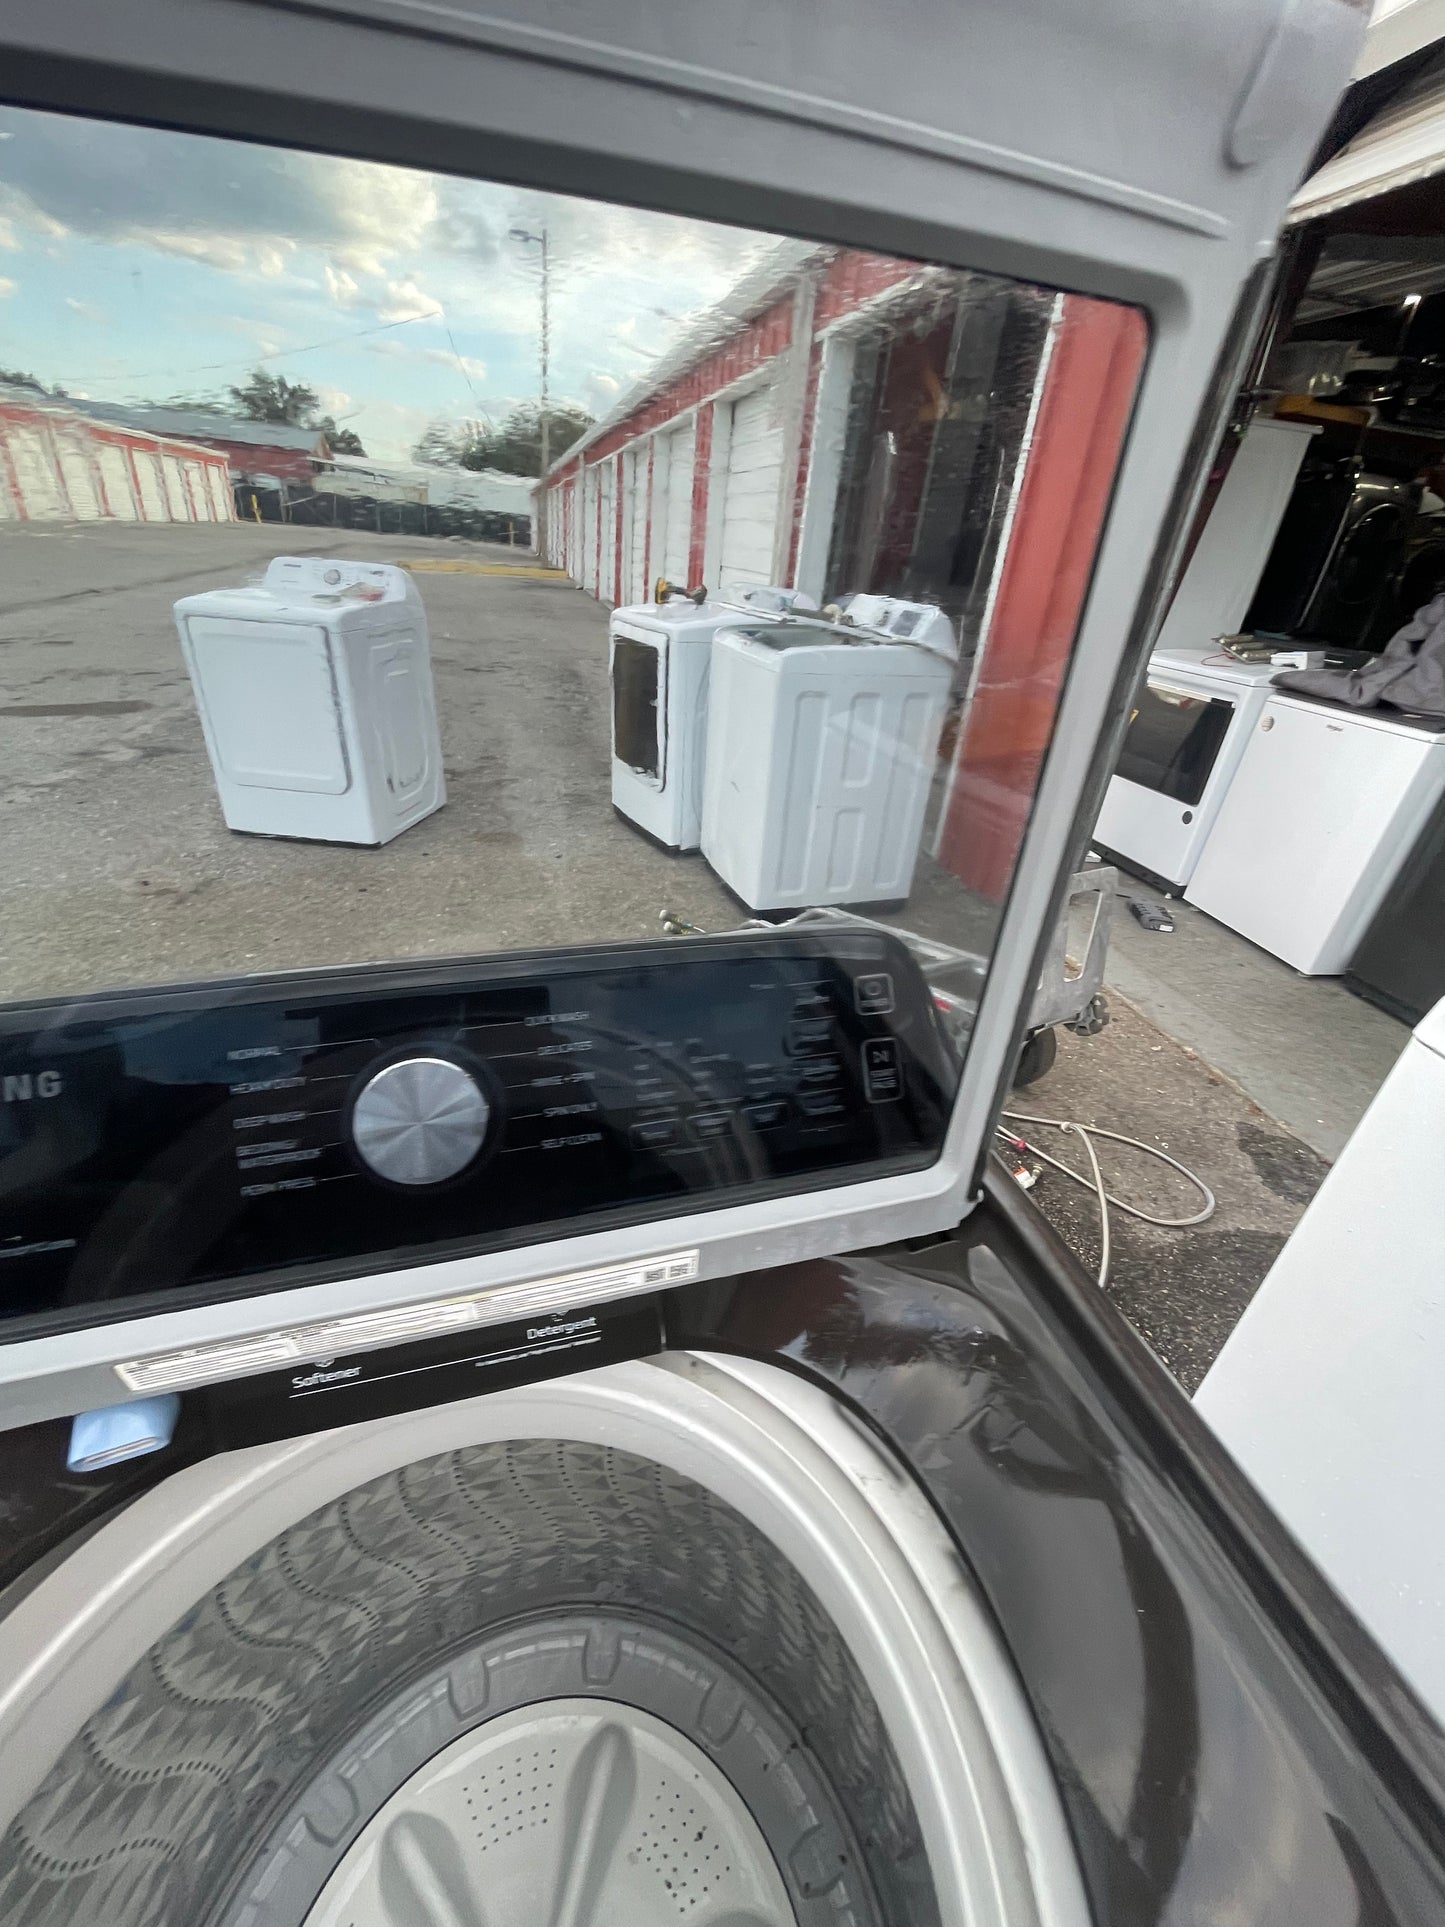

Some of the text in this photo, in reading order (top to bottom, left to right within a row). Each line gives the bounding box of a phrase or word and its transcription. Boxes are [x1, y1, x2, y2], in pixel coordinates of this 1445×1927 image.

[3, 1070, 62, 1102] NG
[526, 1317, 597, 1340] Detergent
[291, 1366, 362, 1389] Softener
